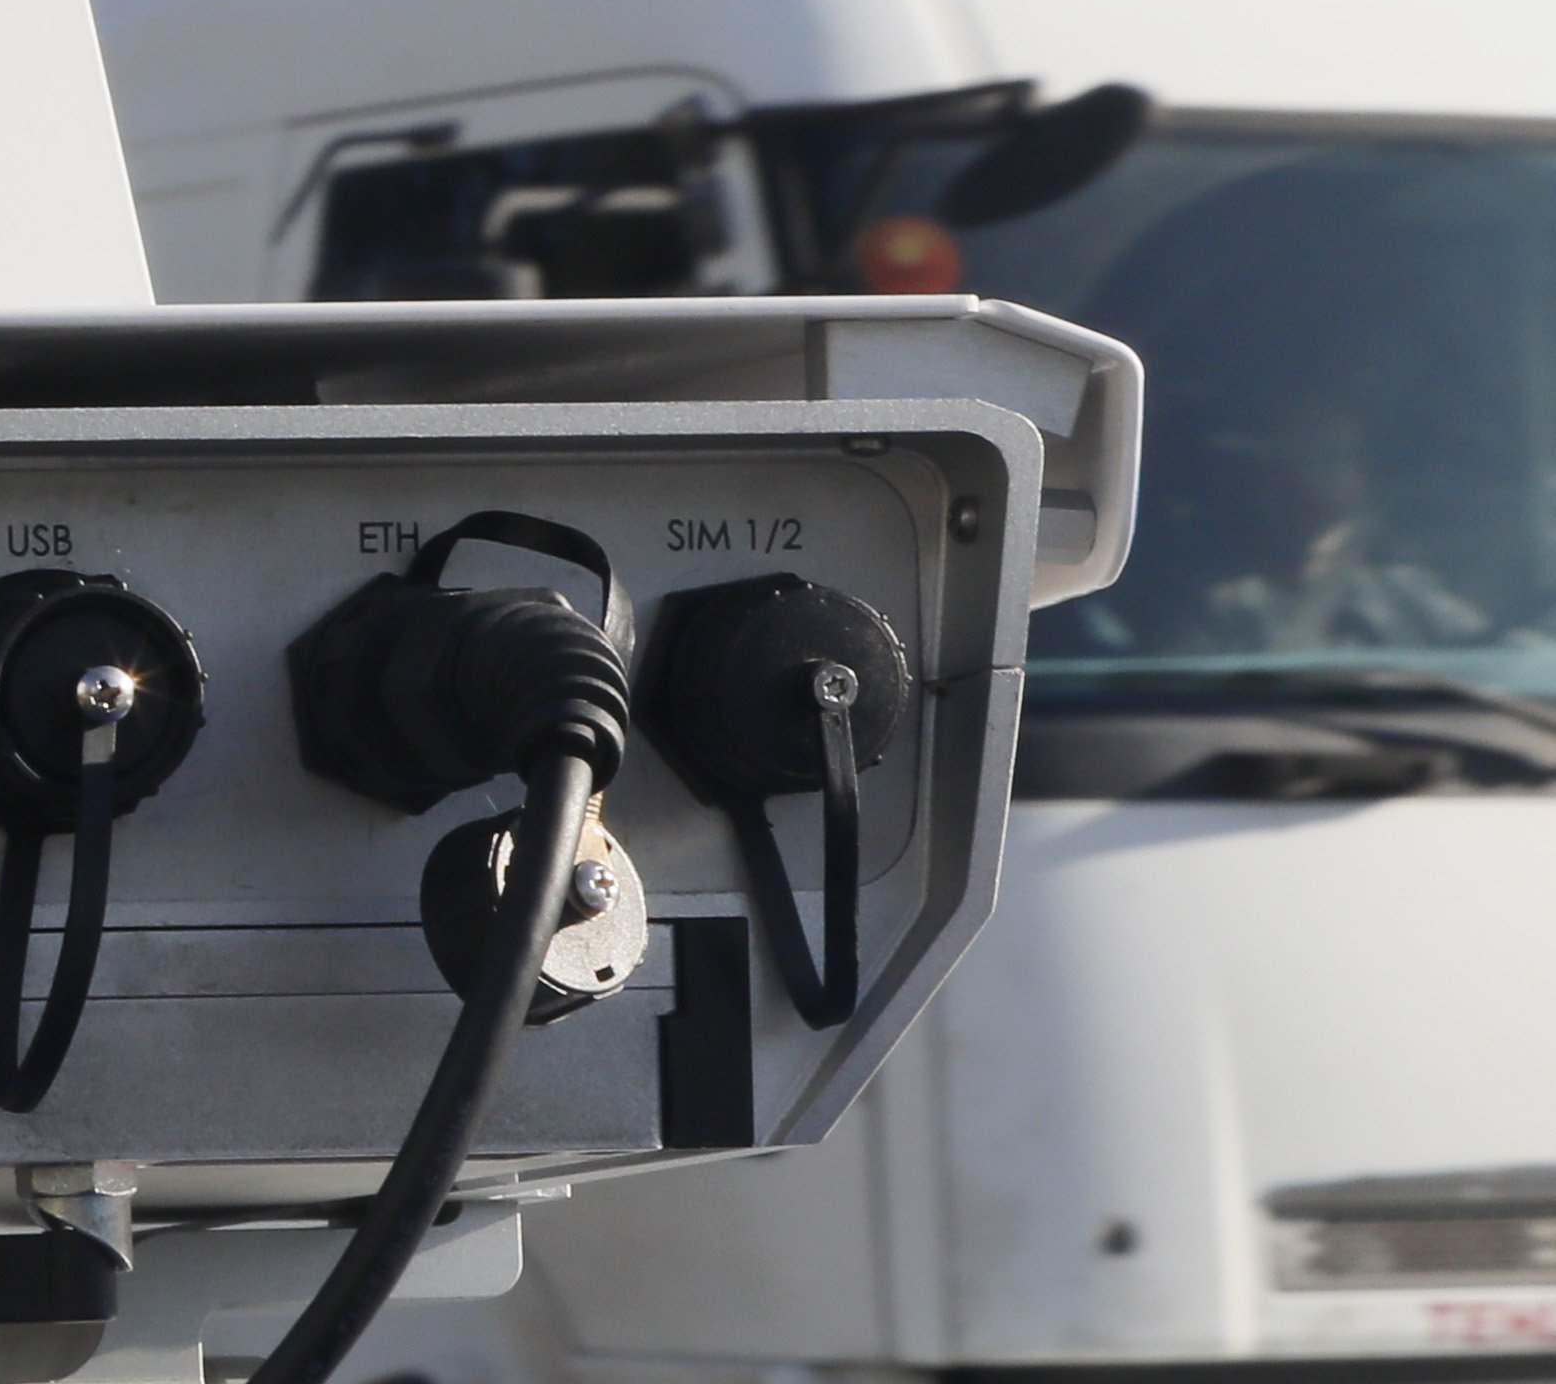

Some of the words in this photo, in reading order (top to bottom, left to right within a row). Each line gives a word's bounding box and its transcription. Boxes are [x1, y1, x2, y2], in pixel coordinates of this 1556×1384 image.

[7, 525, 72, 557] USB
[358, 521, 420, 554] ETH
[667, 518, 731, 552] SIM
[745, 518, 803, 554] 1/2
